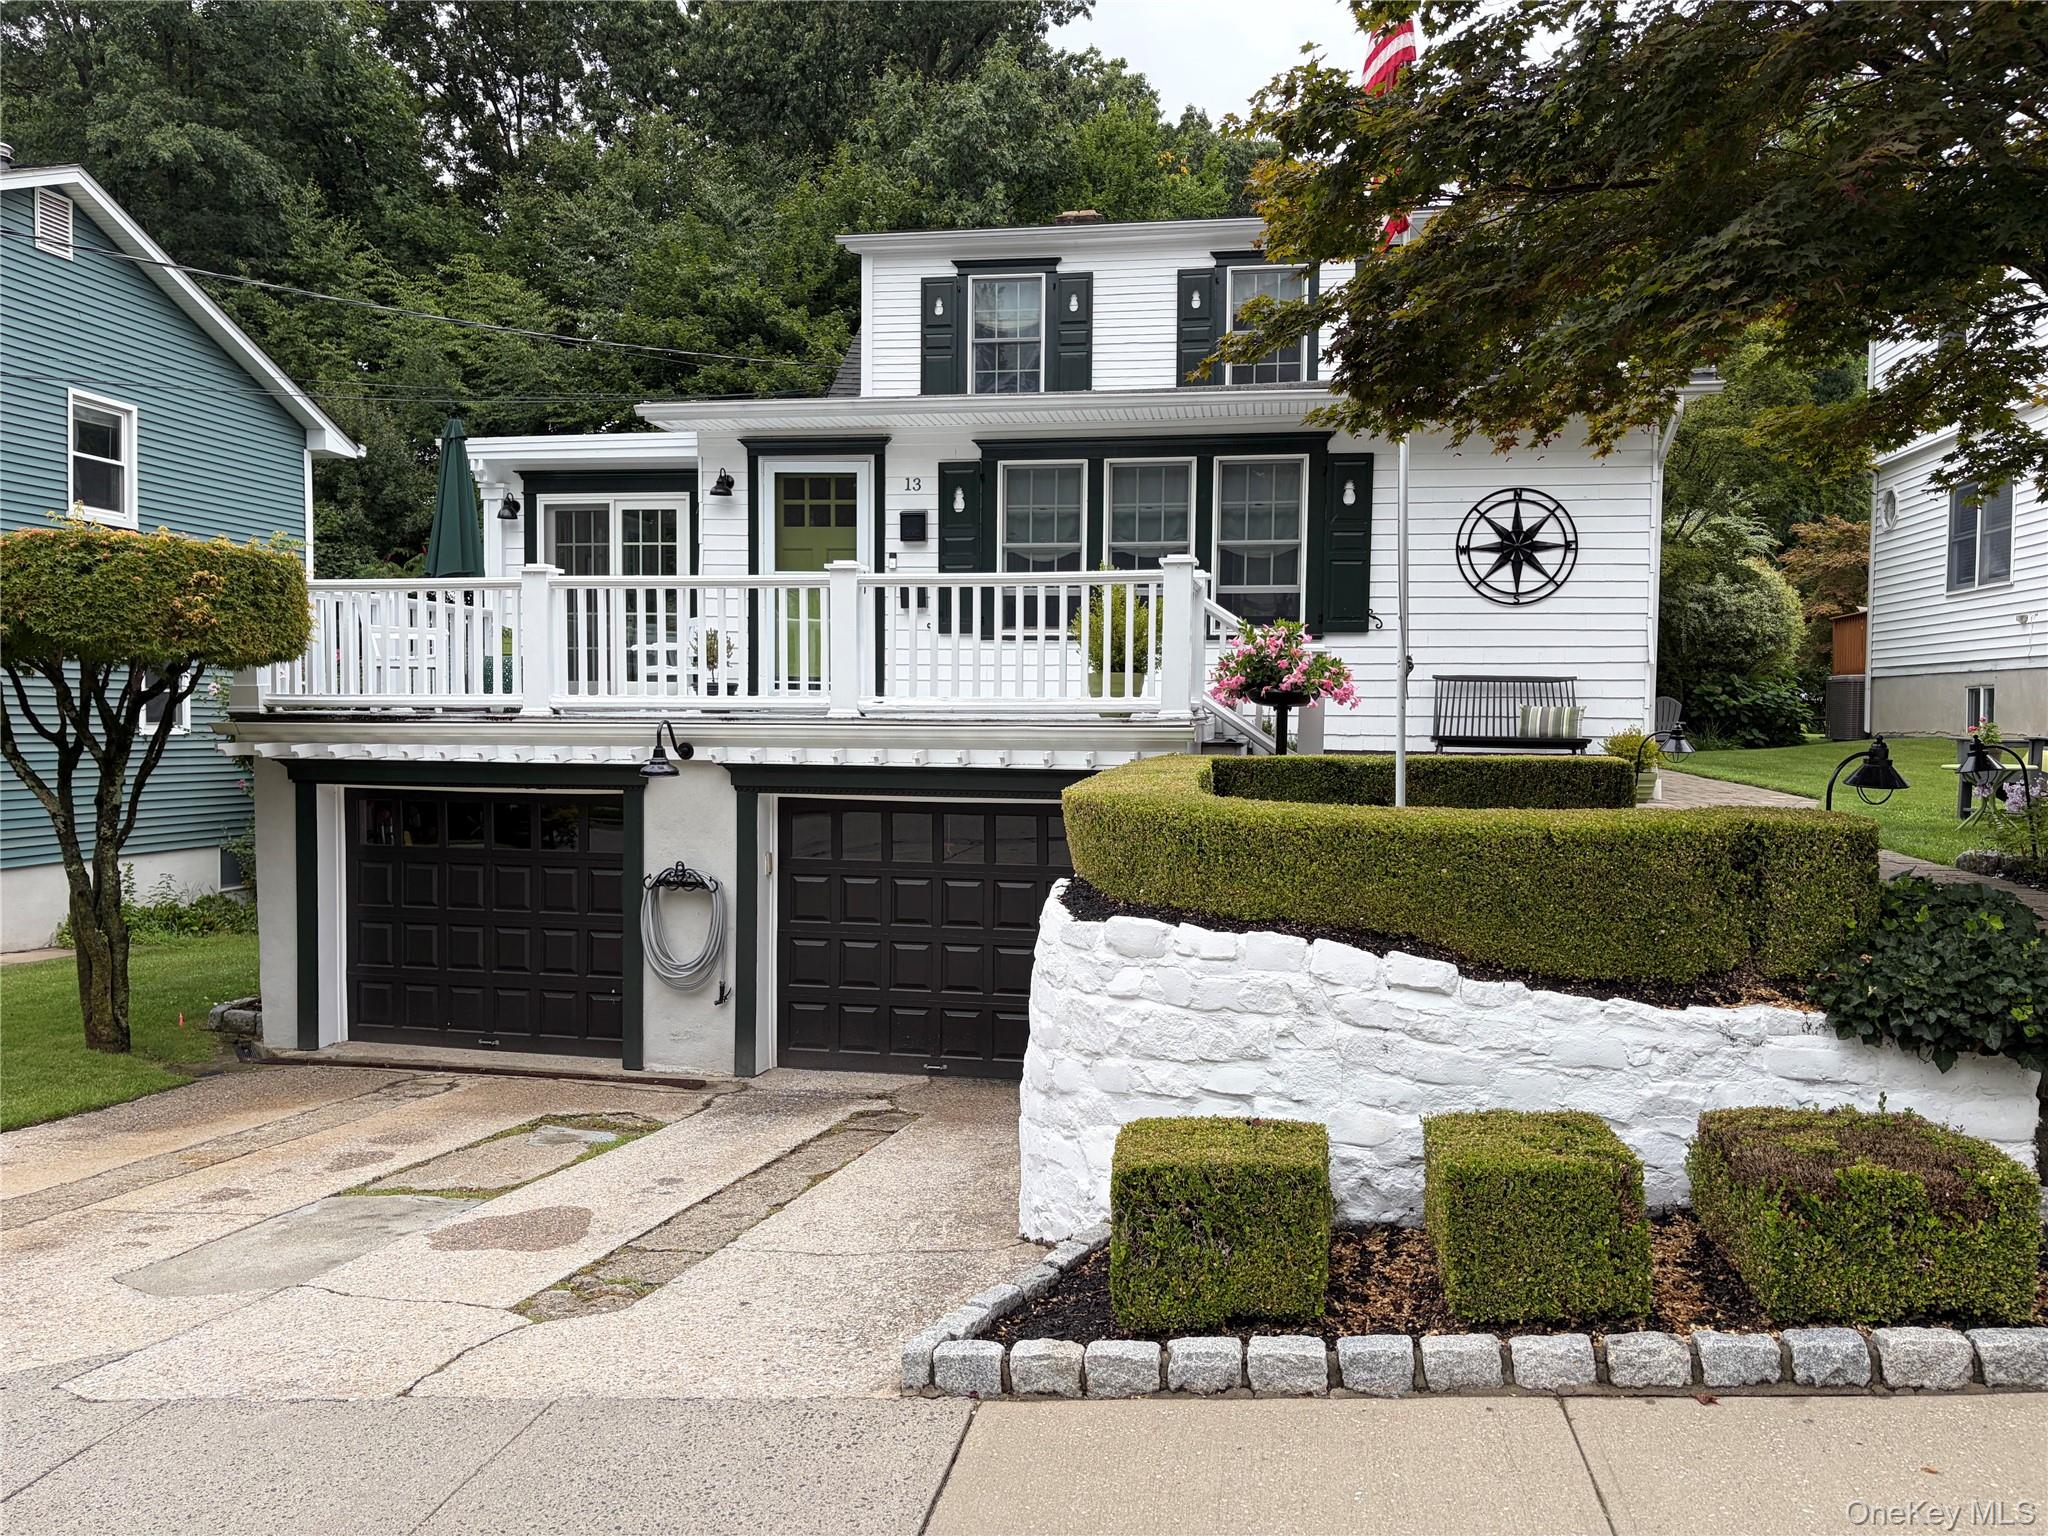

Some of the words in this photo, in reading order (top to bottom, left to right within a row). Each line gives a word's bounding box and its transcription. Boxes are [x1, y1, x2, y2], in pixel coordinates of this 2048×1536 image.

[904, 477, 922, 492] 13
[1513, 488, 1523, 500] N
[1458, 545, 1469, 556] W
[1566, 540, 1577, 551] E
[1513, 593, 1521, 604] S
